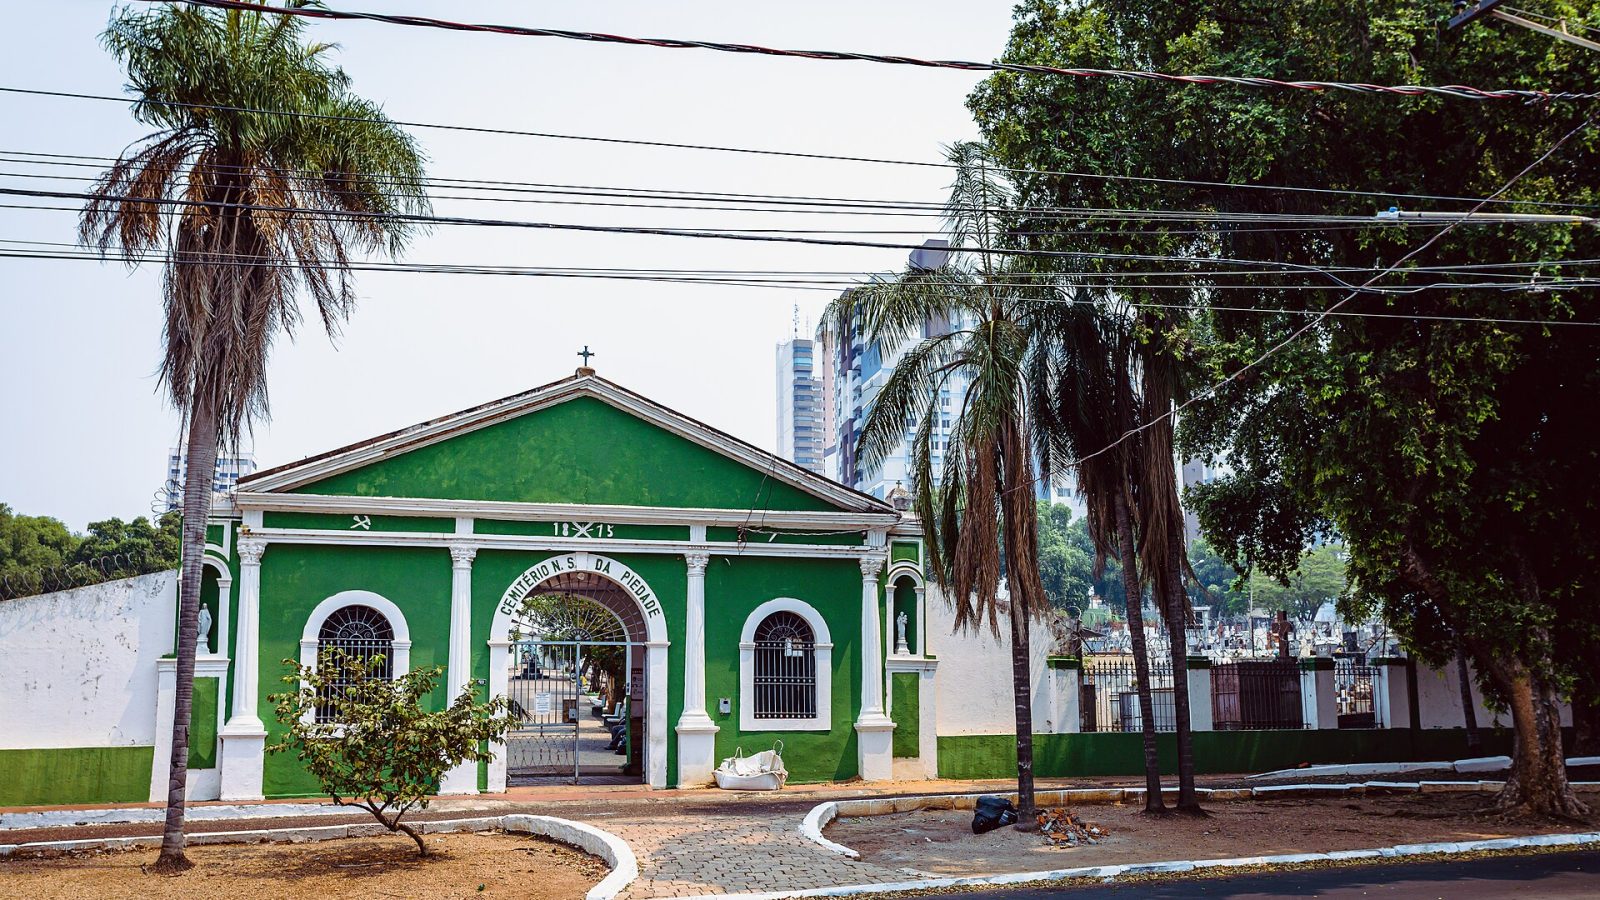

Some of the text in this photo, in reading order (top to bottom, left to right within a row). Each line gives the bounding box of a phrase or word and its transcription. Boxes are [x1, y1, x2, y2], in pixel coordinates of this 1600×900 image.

[553, 522, 569, 537] 18
[500, 564, 550, 616] CEMITÉRIO
[551, 559, 564, 573] N.
[595, 558, 611, 574] DA
[620, 570, 660, 619] PIEDADE
